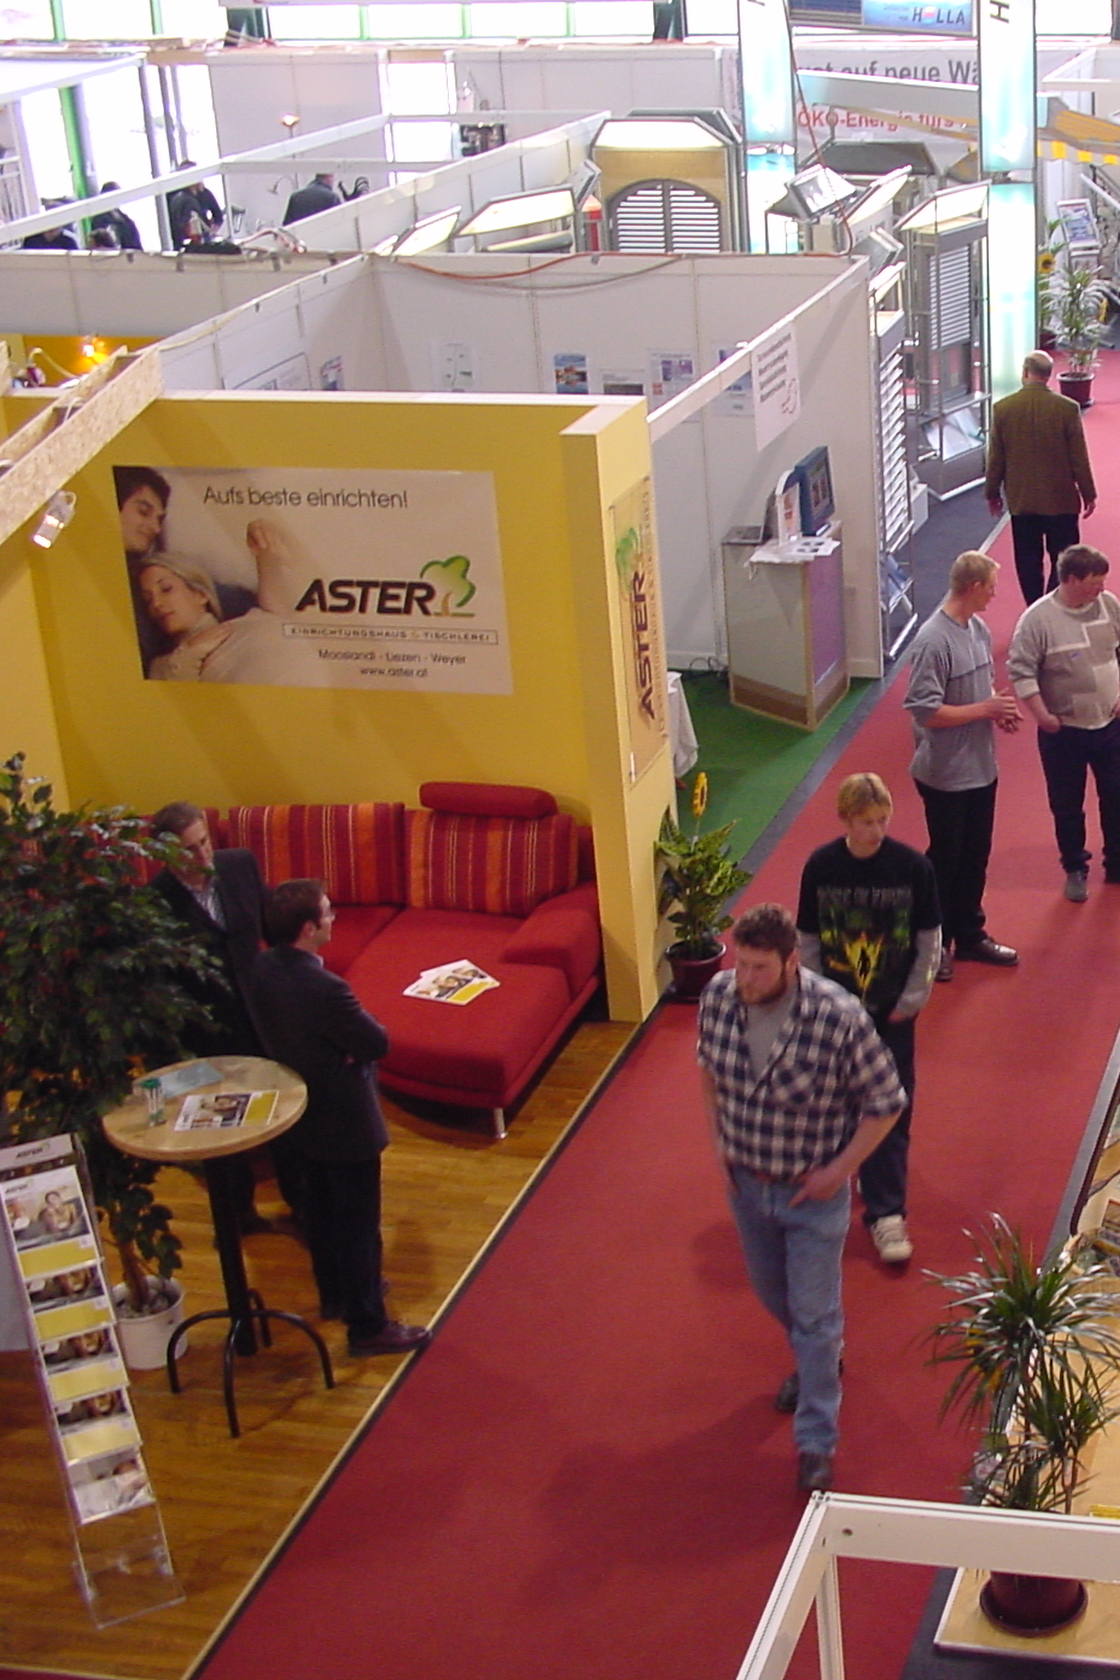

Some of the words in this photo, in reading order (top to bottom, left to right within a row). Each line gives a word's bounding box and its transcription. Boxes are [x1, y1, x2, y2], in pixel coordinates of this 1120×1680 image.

[203, 486, 245, 506] Aufs
[247, 486, 302, 508] beste
[307, 488, 409, 509] einrichten!
[294, 579, 437, 617] ASTER
[632, 570, 655, 720] ASTER
